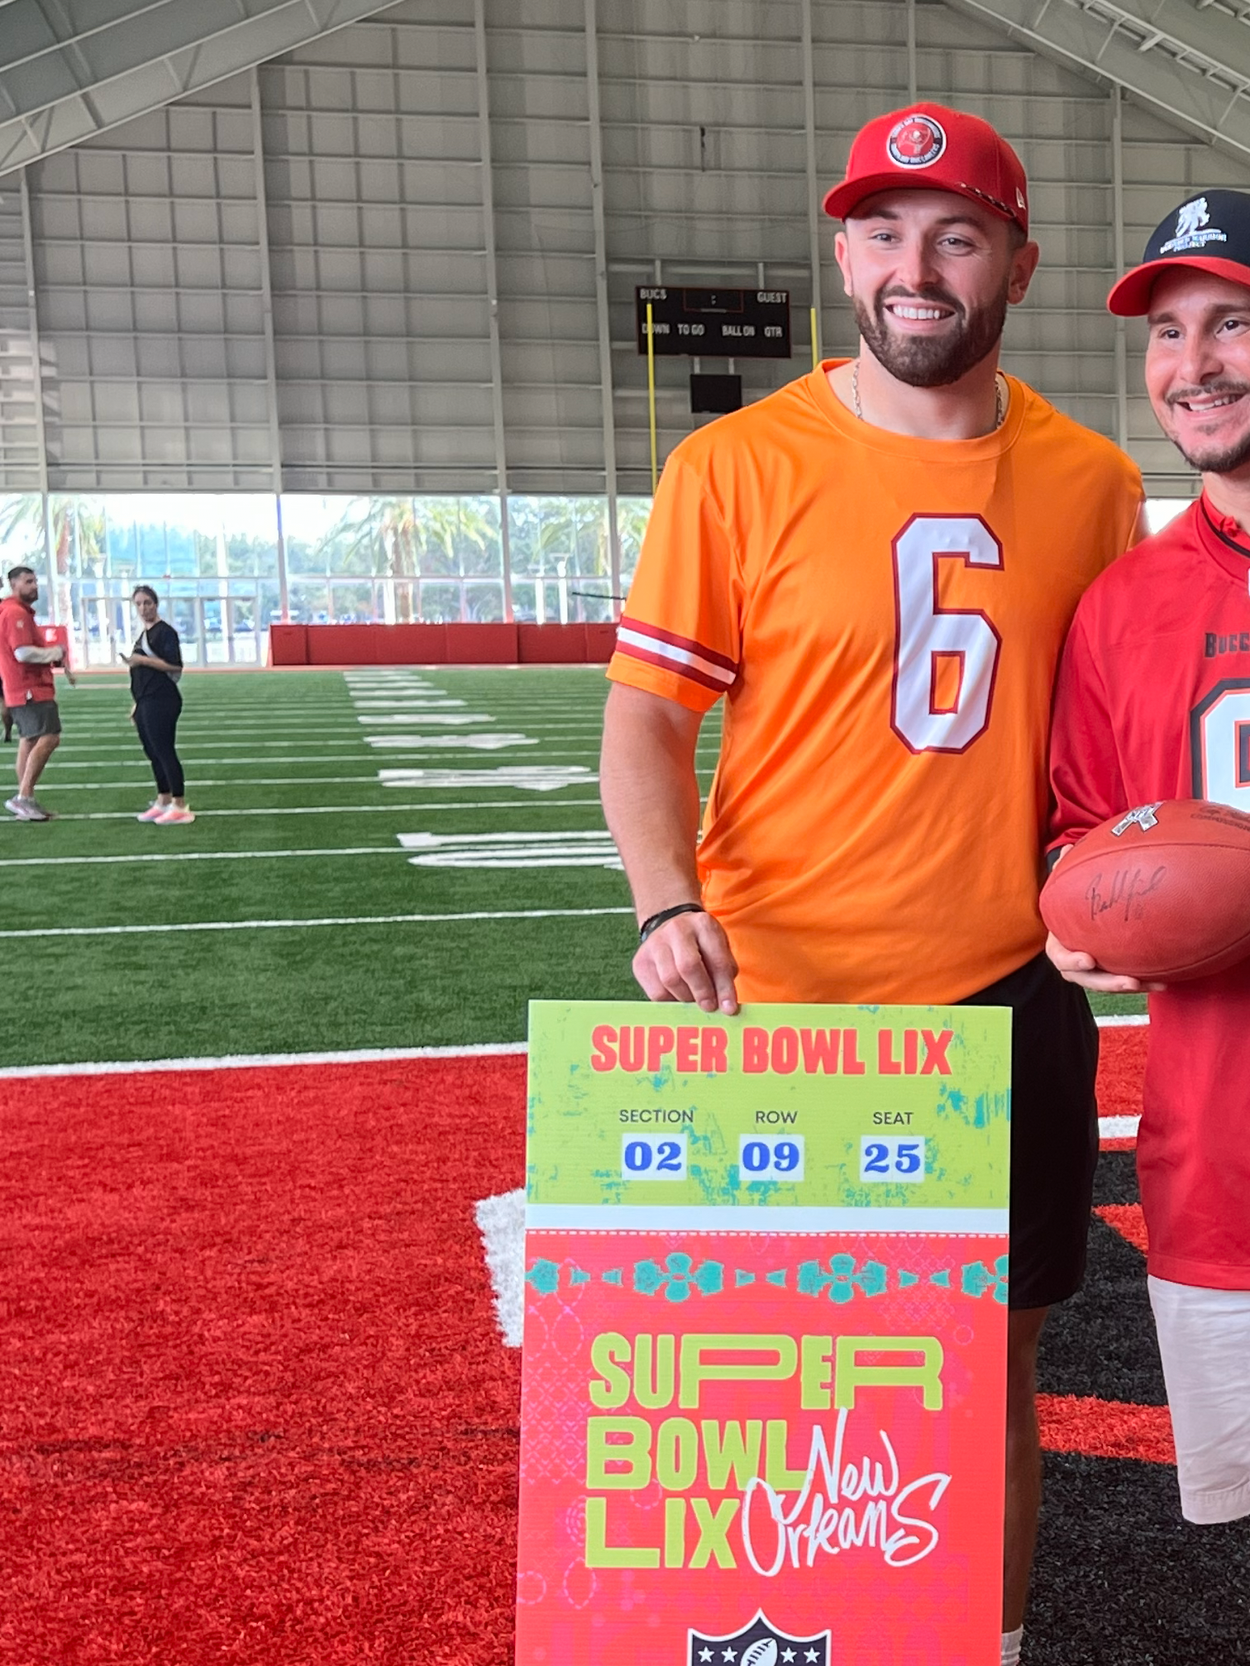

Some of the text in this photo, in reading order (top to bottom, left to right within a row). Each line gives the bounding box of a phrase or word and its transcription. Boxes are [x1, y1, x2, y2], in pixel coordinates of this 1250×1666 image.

[640, 288, 667, 300] BUCS
[757, 291, 787, 304] GUEST
[641, 323, 670, 334] DWN
[677, 323, 705, 336] TO GO
[722, 325, 742, 337] BALL
[891, 512, 1004, 754] 6
[590, 1023, 955, 1076] SUPER BOWL LIX
[619, 1109, 694, 1124] SECTION
[755, 1110, 799, 1125] ROW
[872, 1111, 914, 1126] SEAT
[623, 1141, 683, 1172] 02
[742, 1141, 800, 1173] 09
[863, 1143, 922, 1174] 25
[589, 1332, 945, 1411] SUPER
[585, 1415, 808, 1491] BOWL
[785, 1407, 900, 1508] New
[584, 1497, 741, 1569] LIX
[741, 1474, 952, 1577] Orleans
